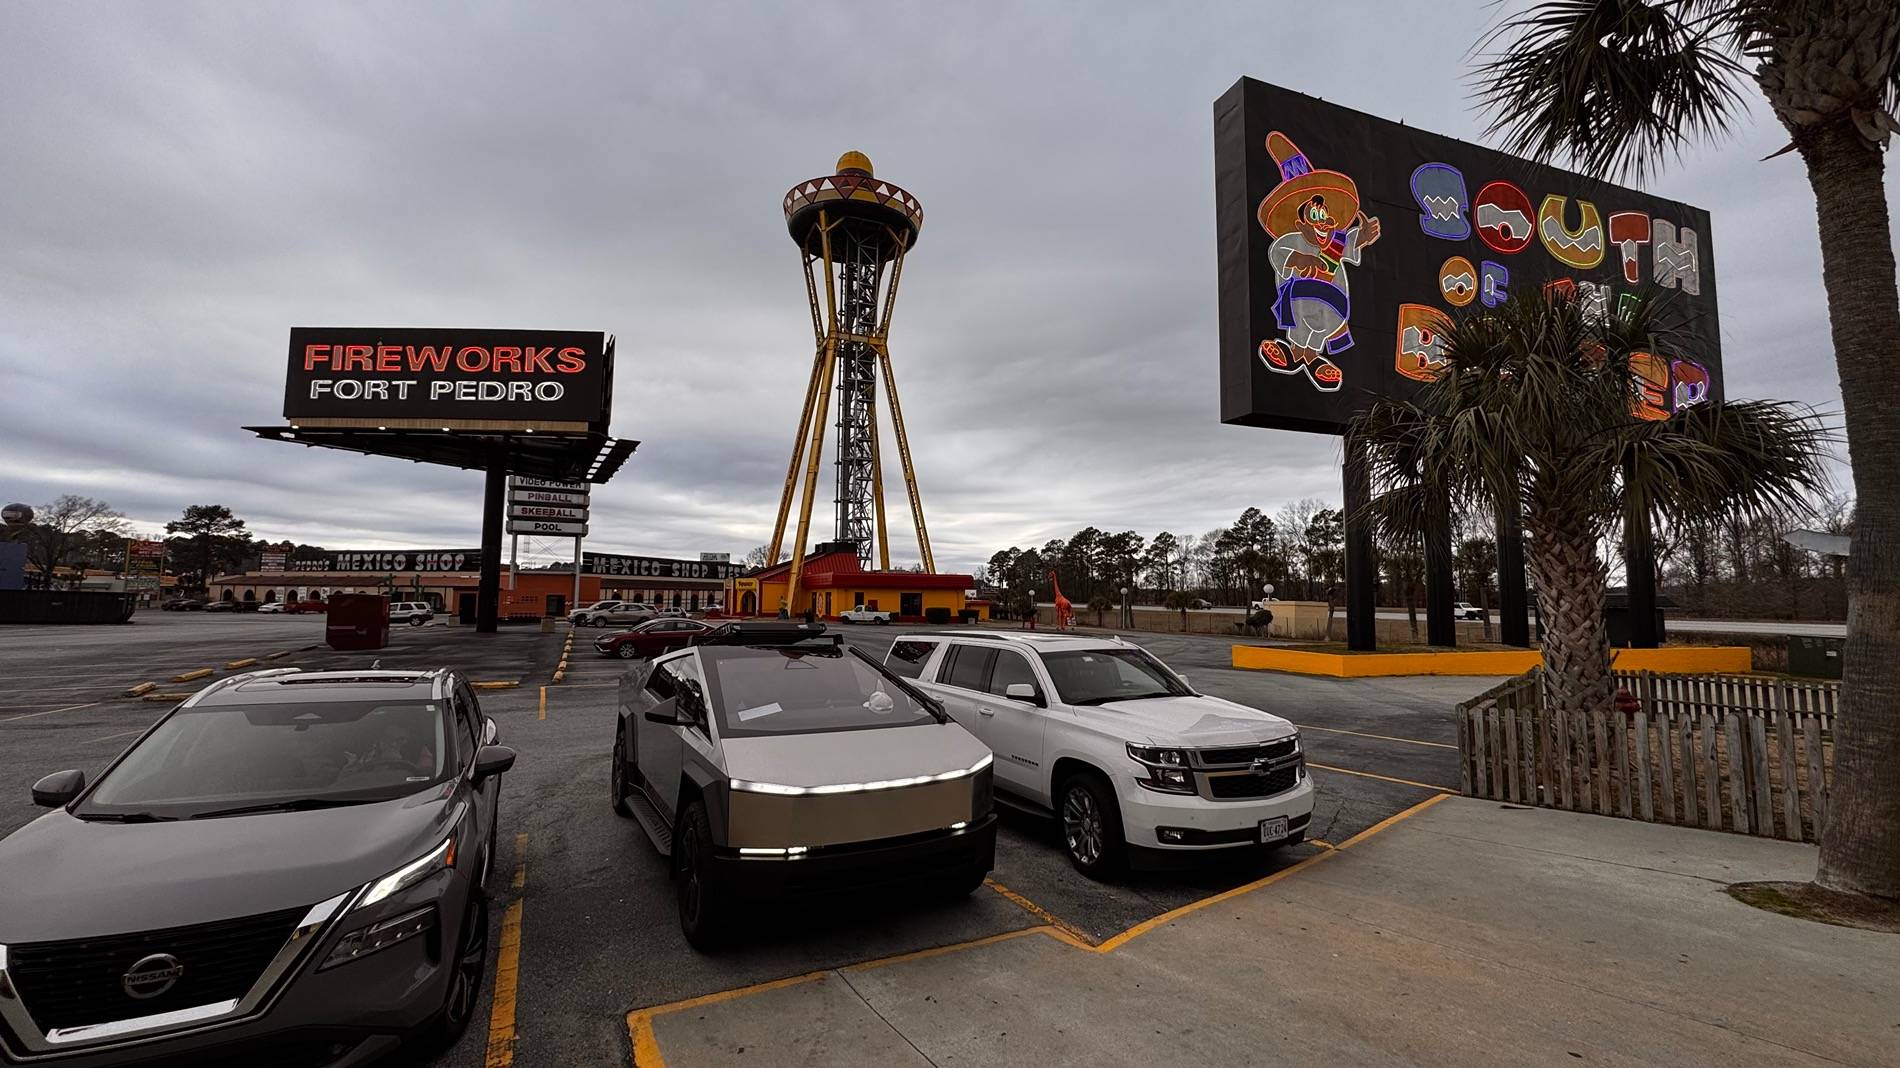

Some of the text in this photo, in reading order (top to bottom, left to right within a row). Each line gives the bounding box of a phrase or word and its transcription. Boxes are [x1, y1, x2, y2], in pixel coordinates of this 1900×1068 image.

[1409, 161, 1701, 296] SOUTH
[1438, 255, 1509, 308] OF
[303, 343, 587, 374] FIREWORKS
[309, 379, 565, 402] FORT PEDRO
[519, 477, 546, 487] VIDEO
[527, 492, 572, 502] PINBALL
[521, 507, 576, 518] SKEEBALL
[534, 523, 562, 532] POOL
[295, 558, 330, 572] PEDRO'S
[335, 552, 407, 572] MEXICO
[415, 552, 466, 571] SHOP
[592, 557, 660, 576] MEXICO
[671, 562, 709, 579] SHOP
[126, 970, 178, 983] NISSAN
